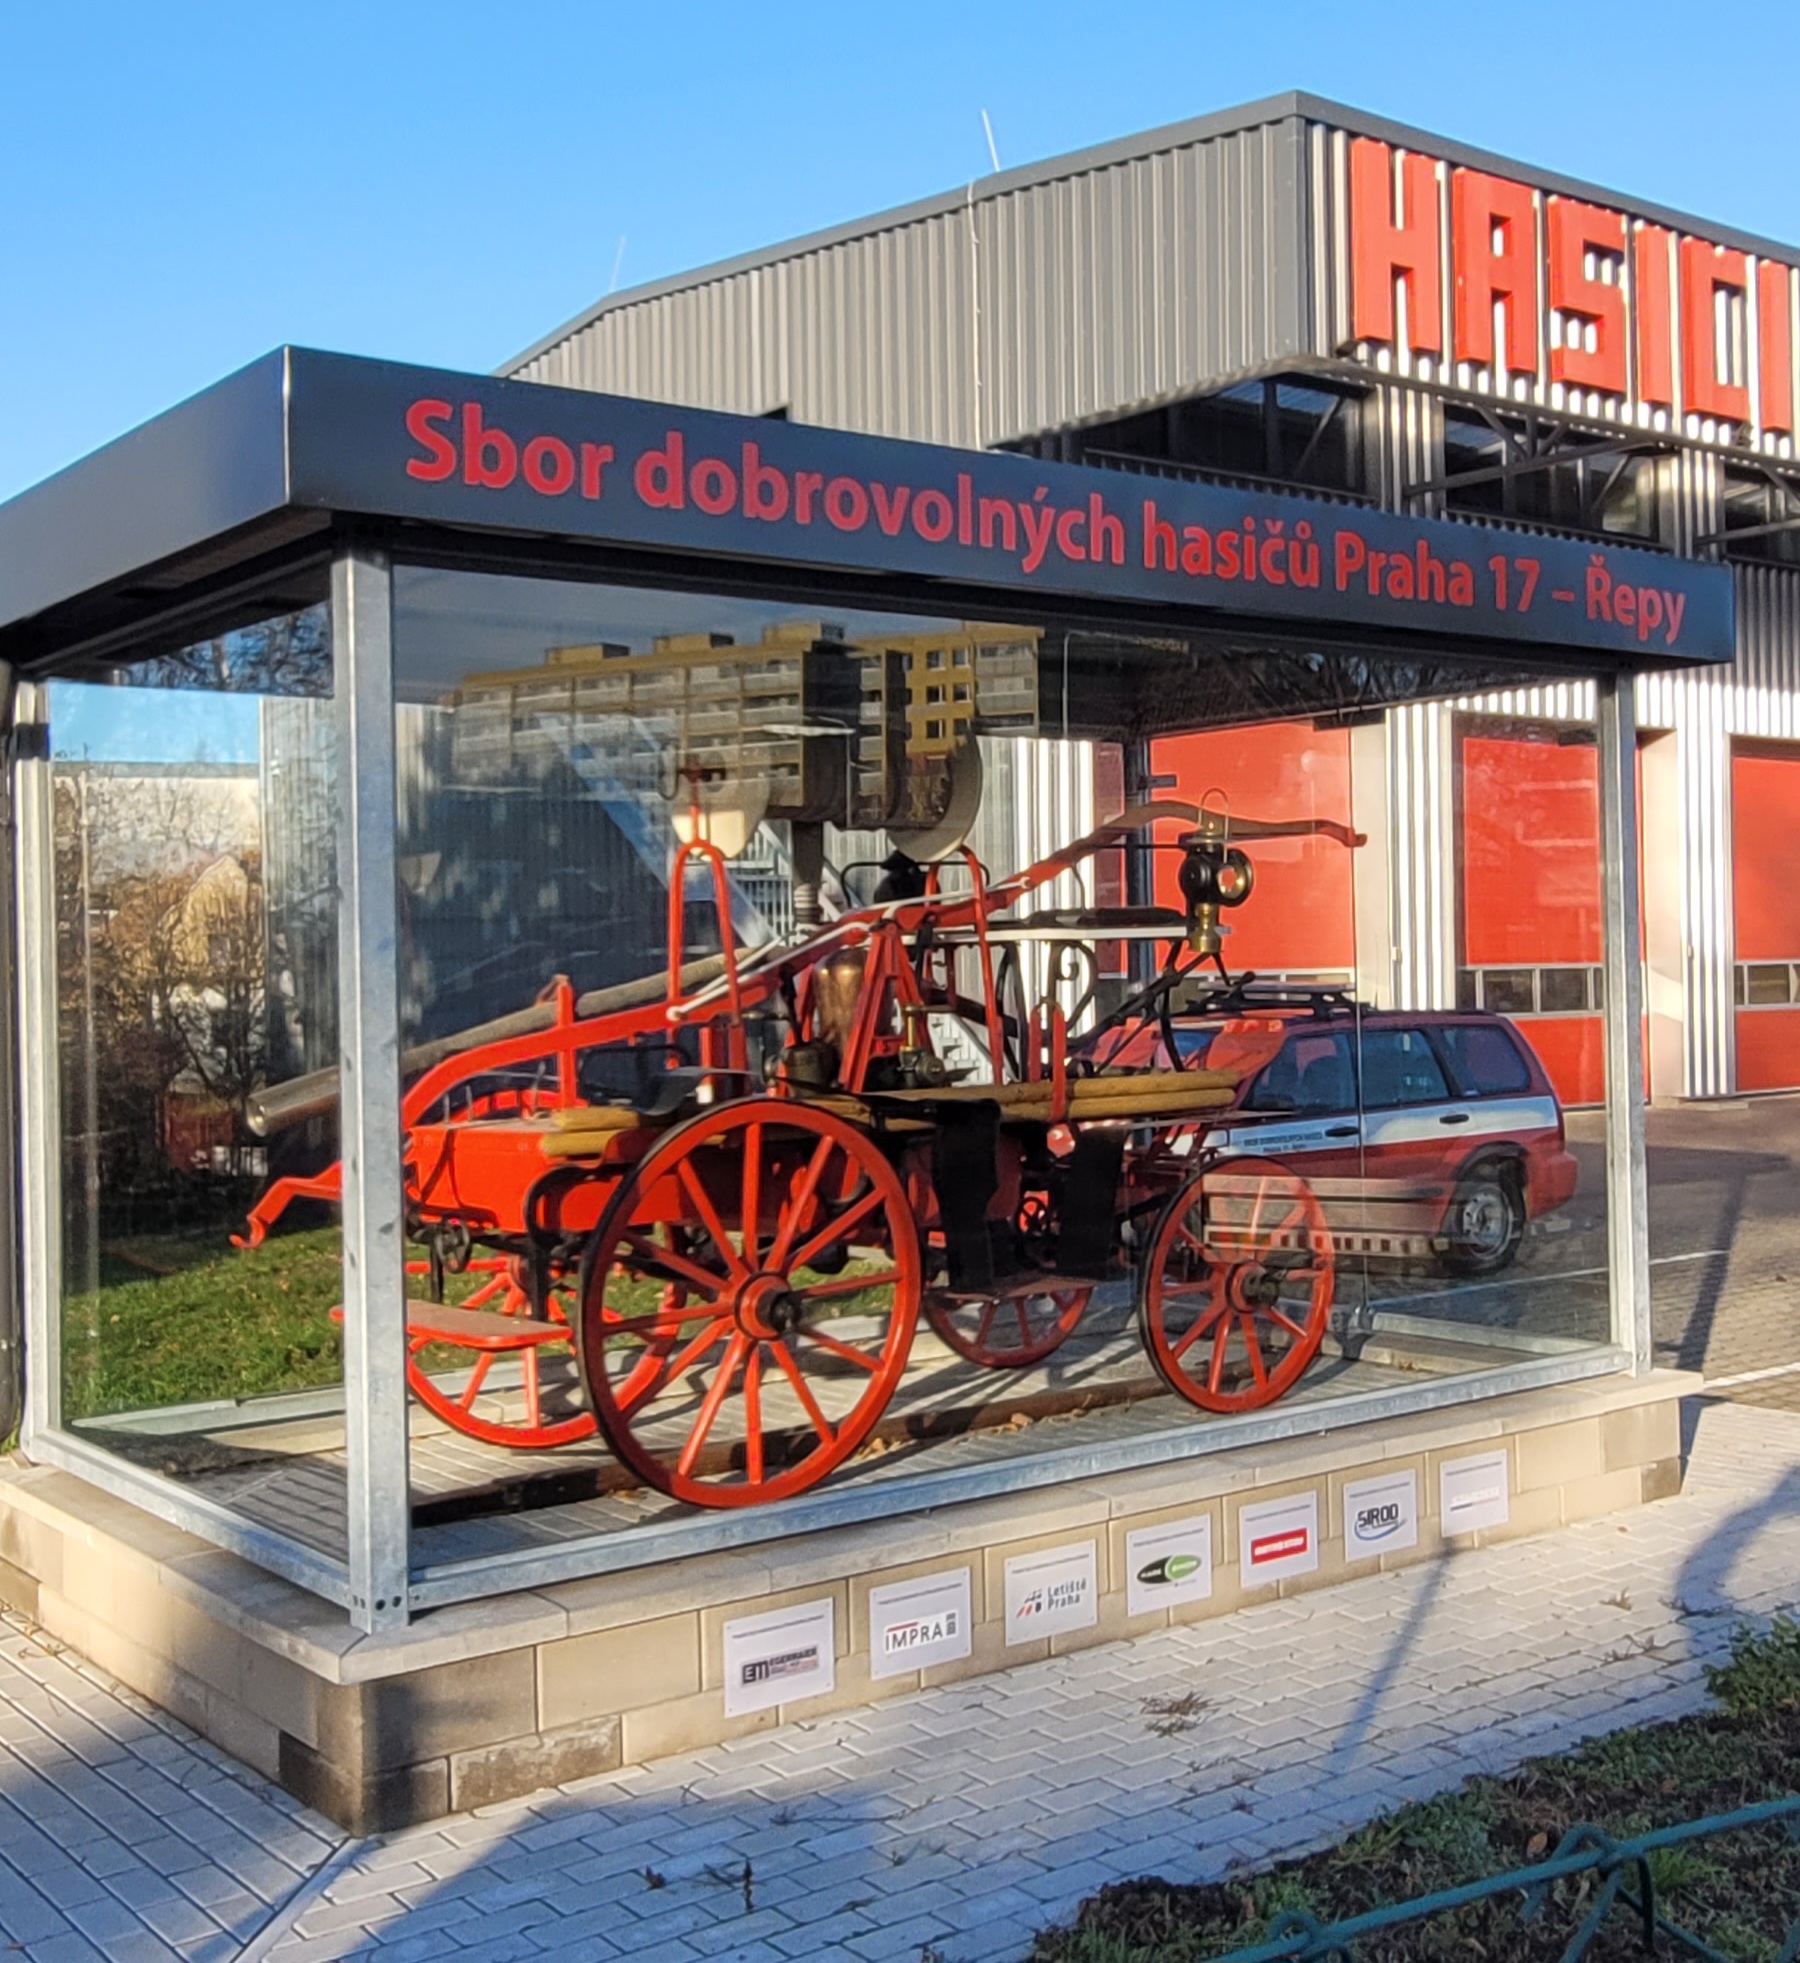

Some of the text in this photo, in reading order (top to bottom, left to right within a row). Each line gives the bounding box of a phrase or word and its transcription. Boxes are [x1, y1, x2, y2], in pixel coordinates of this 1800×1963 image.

[405, 399, 614, 499] Sbor
[634, 431, 1125, 574] dobrovolných
[1143, 500, 1320, 588] hasičů
[1334, 531, 1475, 606] Praha
[1488, 555, 1541, 611] 17
[1586, 555, 1686, 643] Řepy
[885, 1621, 943, 1652] IMPRA
